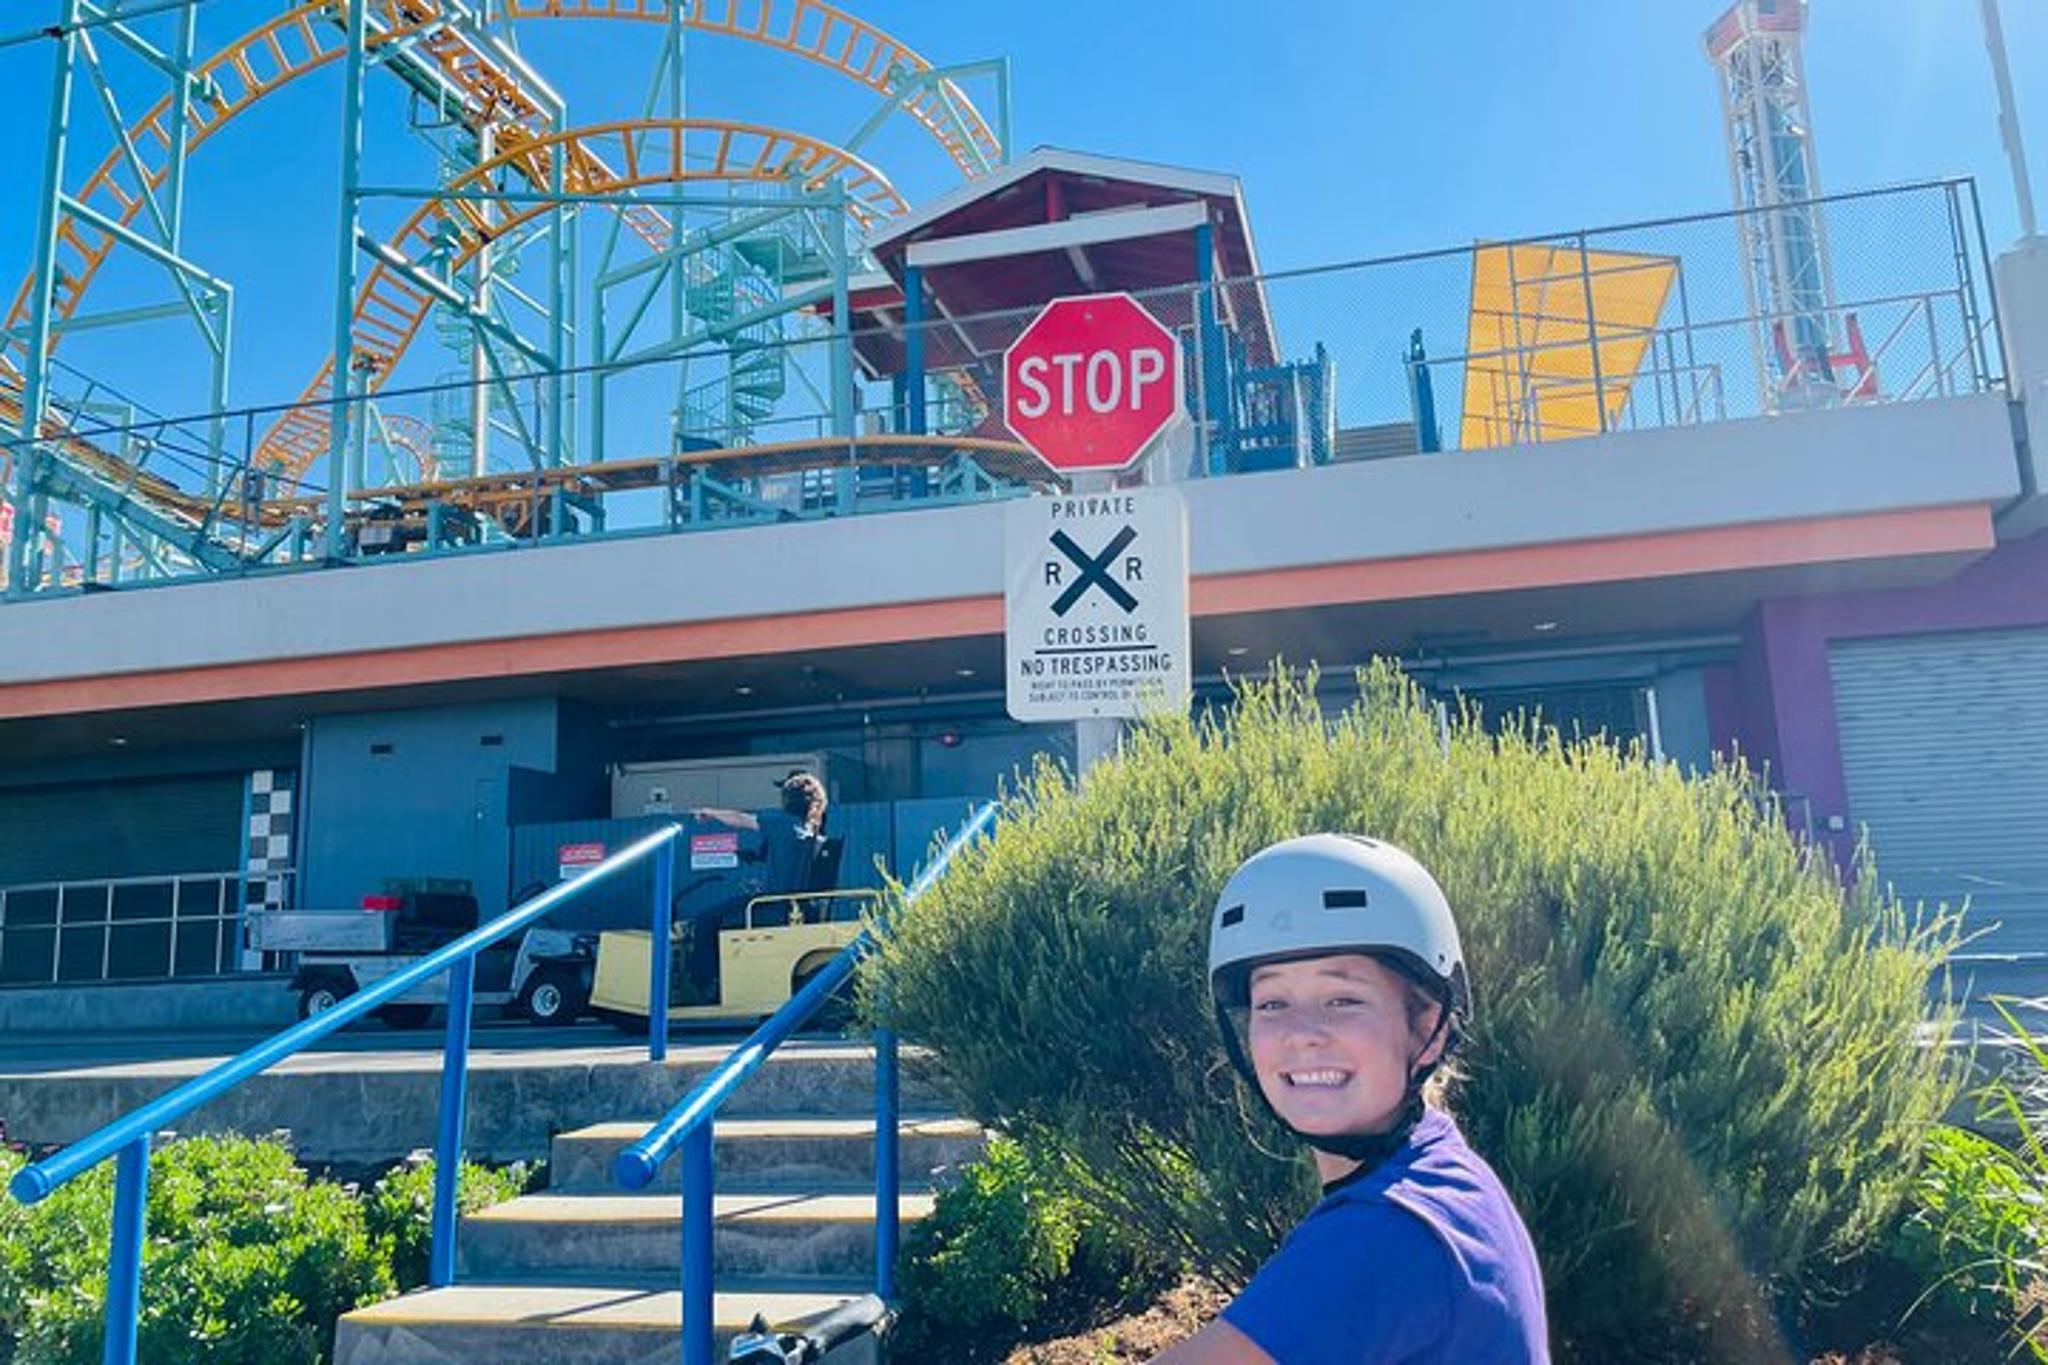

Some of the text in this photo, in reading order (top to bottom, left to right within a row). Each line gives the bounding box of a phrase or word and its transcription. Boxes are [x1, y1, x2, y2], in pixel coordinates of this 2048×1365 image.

[1017, 347, 1165, 418] STOP
[1052, 497, 1135, 518] PRIVATE
[1045, 562, 1061, 585] R
[1126, 557, 1142, 580] R
[1044, 625, 1147, 645] CROSSING
[1020, 653, 1171, 677] NO TRESPASSING
